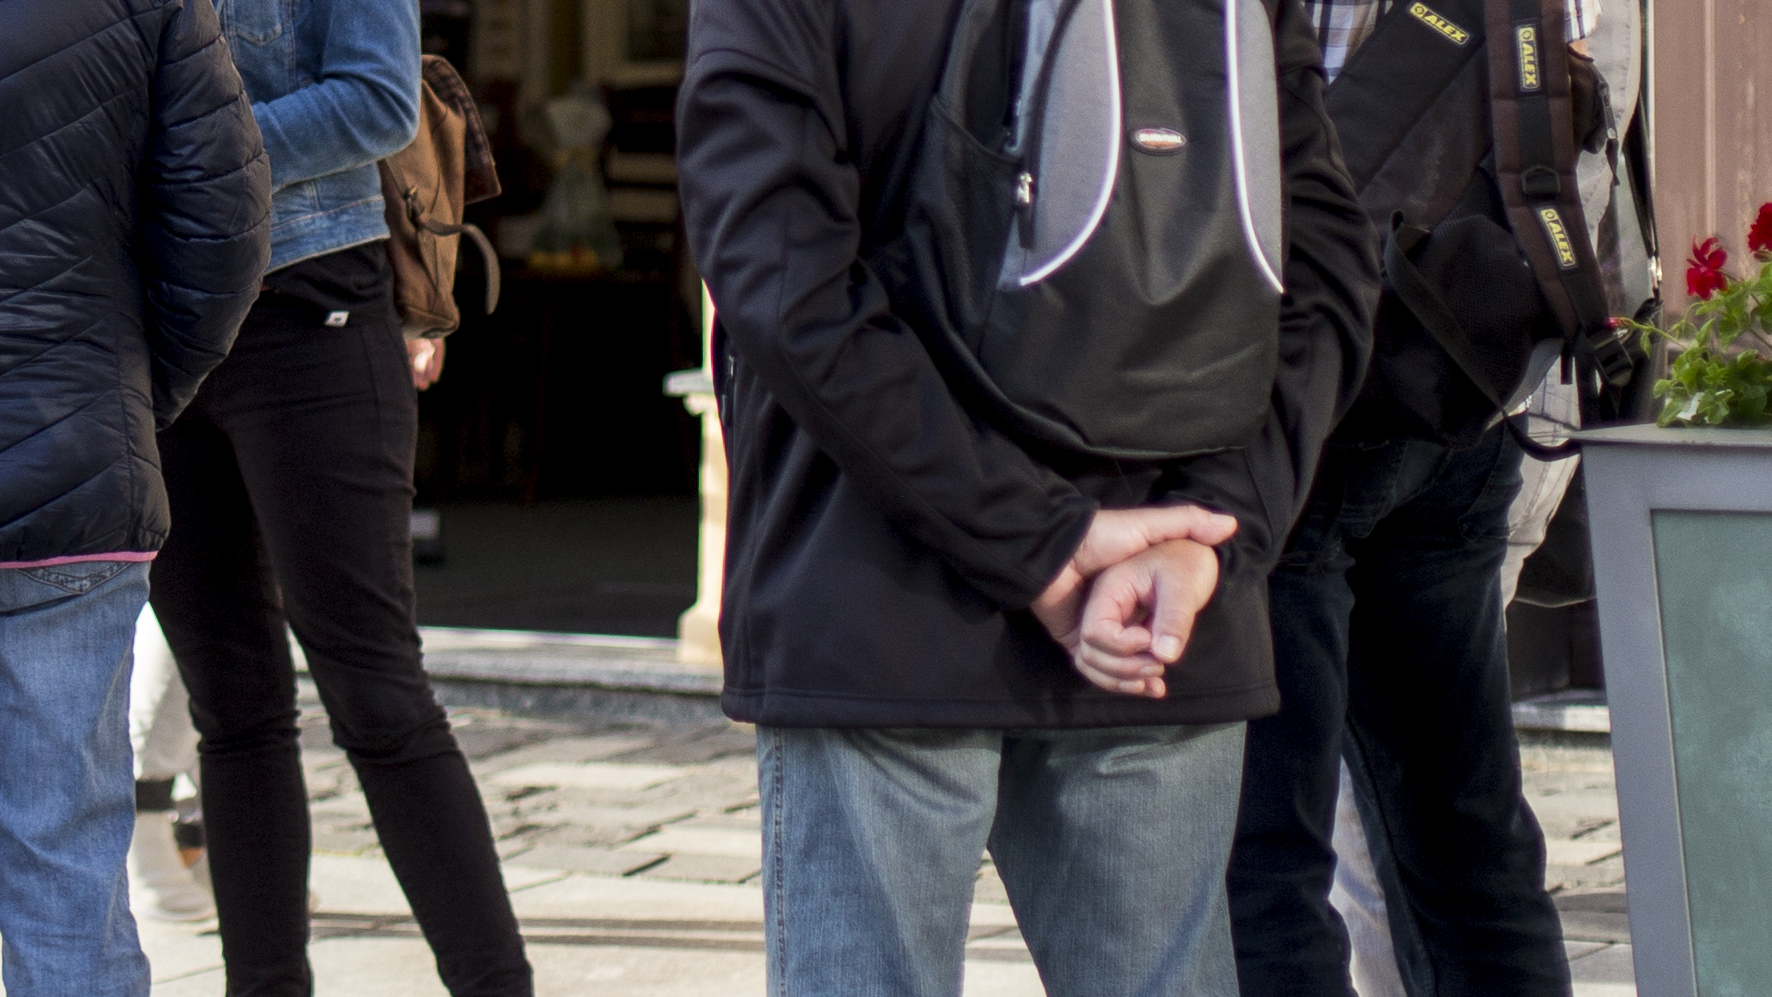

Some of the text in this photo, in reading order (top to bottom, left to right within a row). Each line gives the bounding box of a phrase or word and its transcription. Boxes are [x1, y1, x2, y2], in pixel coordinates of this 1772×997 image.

[1424, 14, 1467, 42] ALEX
[1521, 42, 1537, 85] ALEX
[1549, 221, 1574, 262] ALEX
